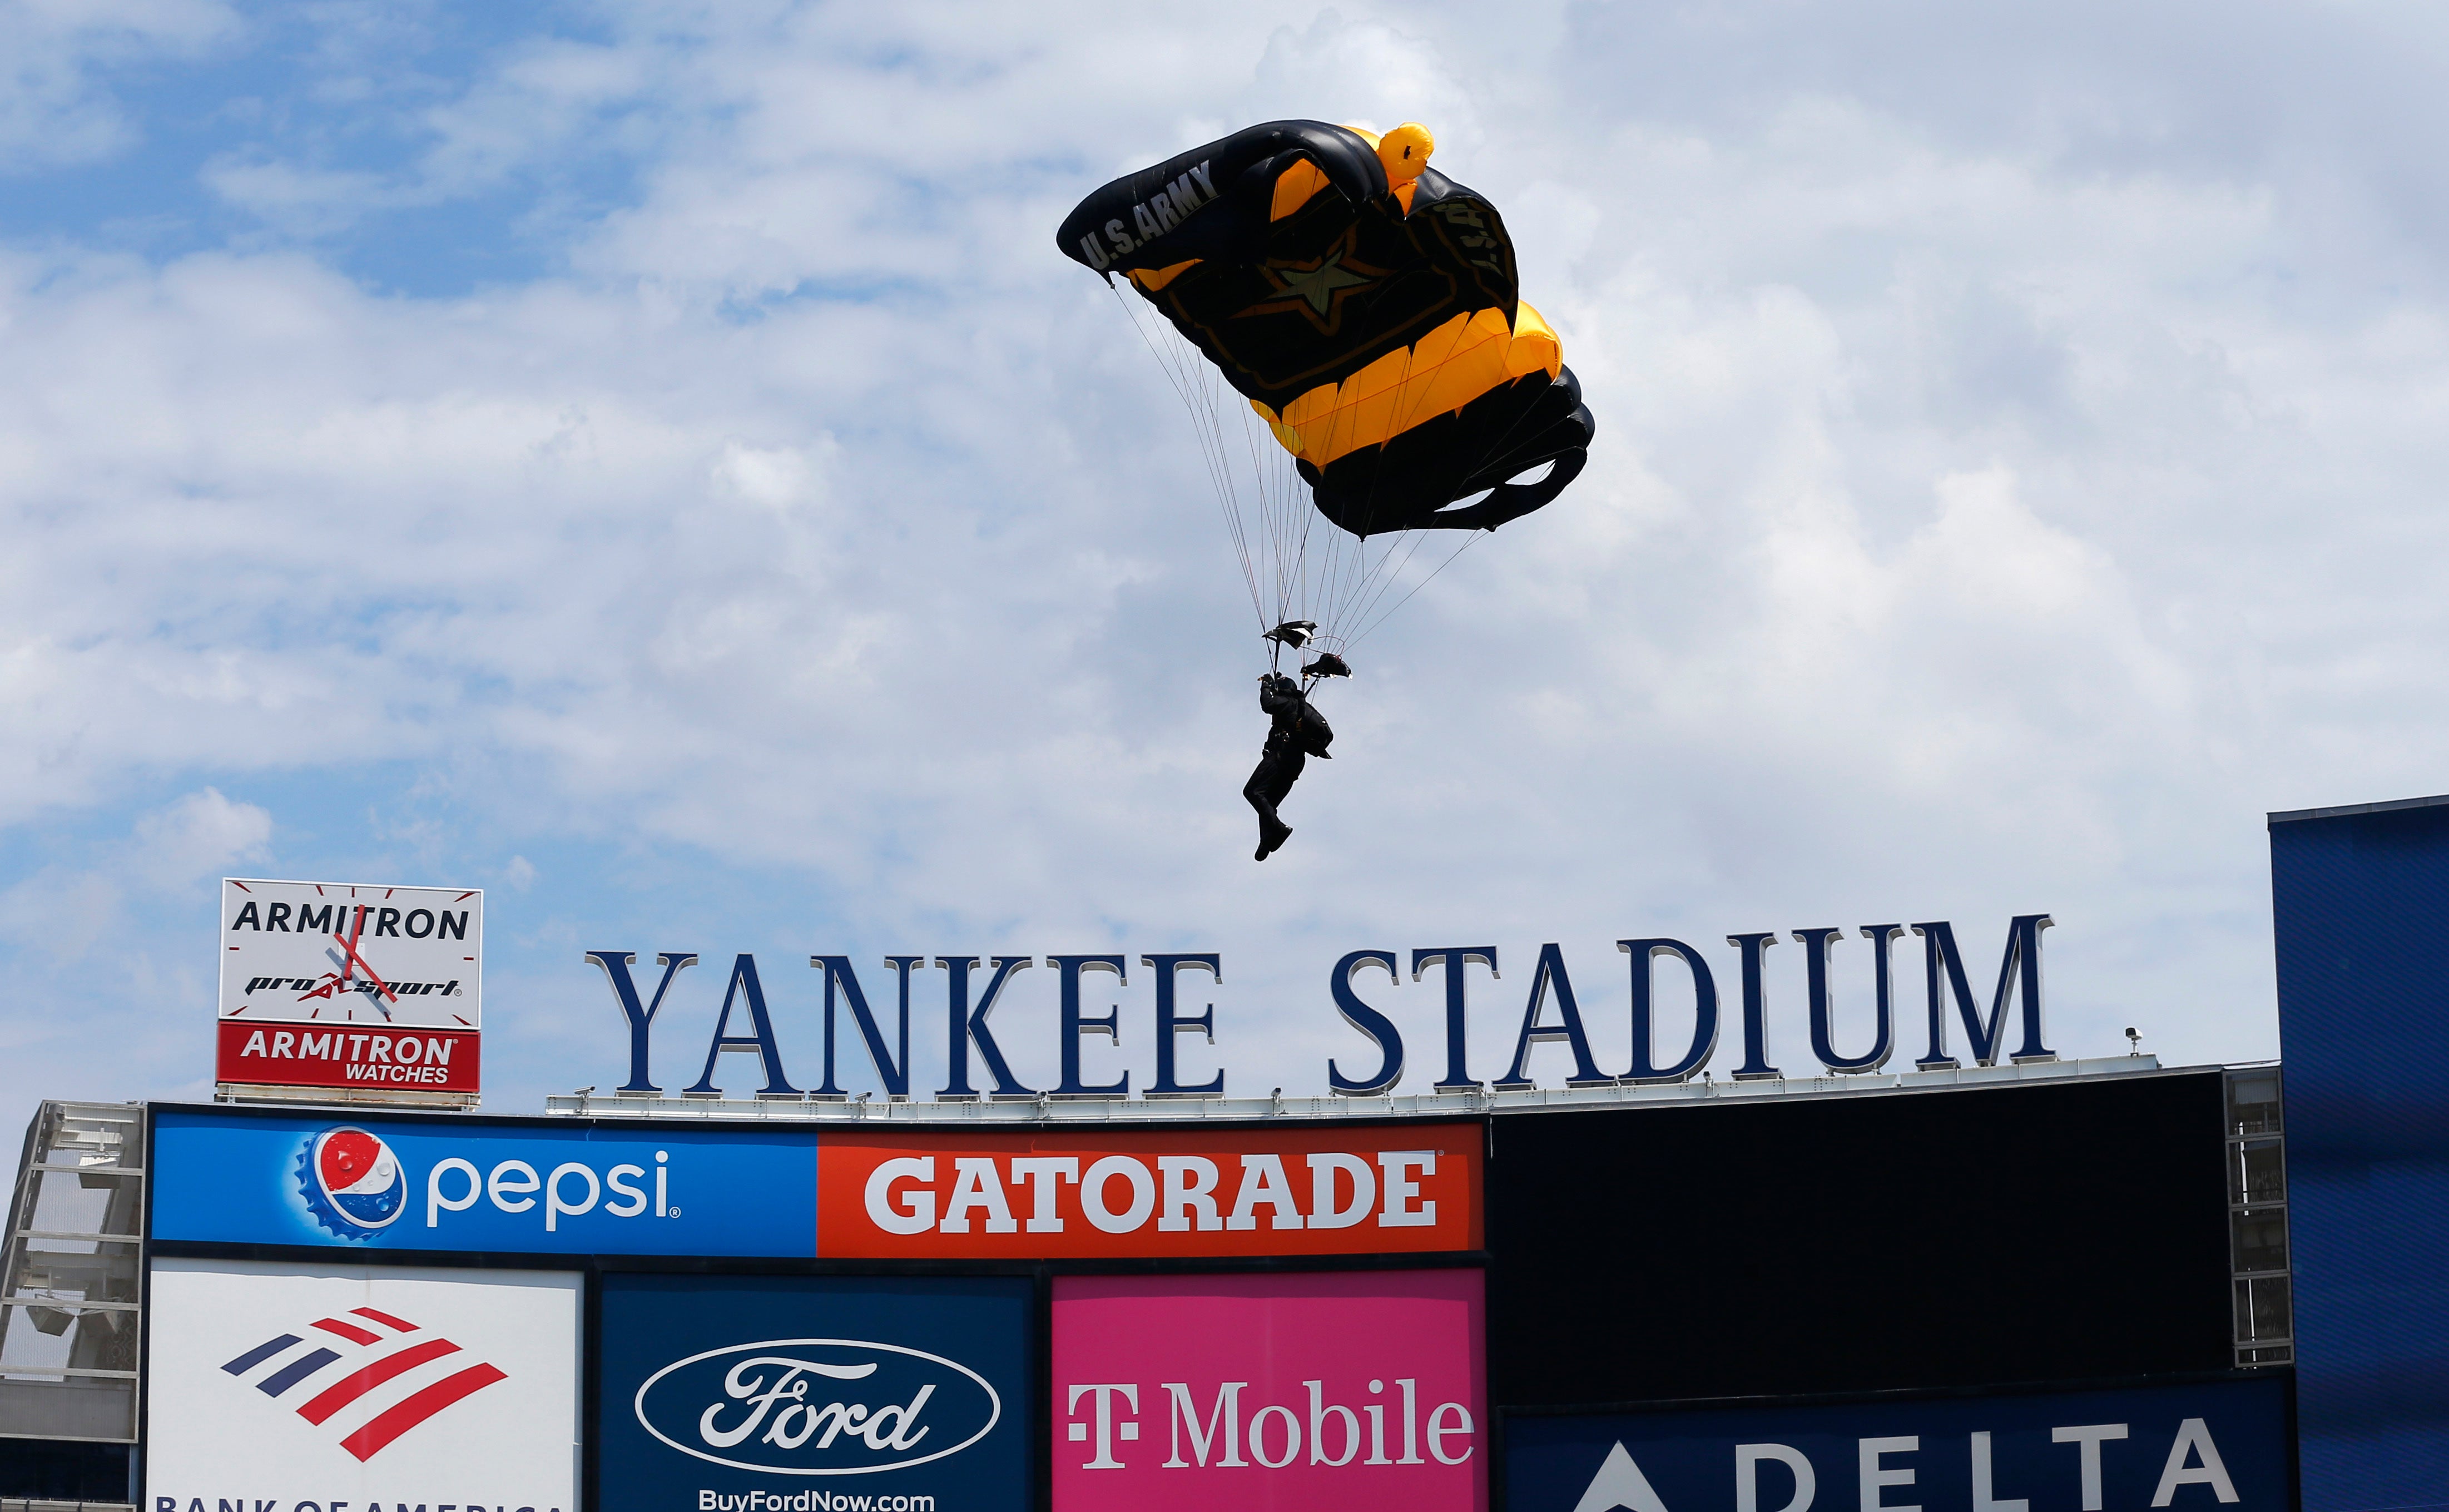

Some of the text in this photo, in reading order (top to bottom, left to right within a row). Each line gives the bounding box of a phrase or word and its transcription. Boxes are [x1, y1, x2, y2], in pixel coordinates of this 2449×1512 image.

[232, 901, 469, 940] ARMITRON
[245, 977, 316, 996] pro
[585, 912, 2056, 1098] YANKEE STADIUM
[240, 1030, 452, 1065] ARMITRON
[345, 1064, 449, 1084] WATCHES
[428, 1150, 668, 1232] pepsi
[864, 1151, 1437, 1235] GATORADE
[700, 1357, 936, 1450] Ford
[1161, 1378, 1475, 1469] Mobile
[698, 1490, 935, 1512] BuyFordNow.com
[1736, 1417, 2240, 1512] DELTA
